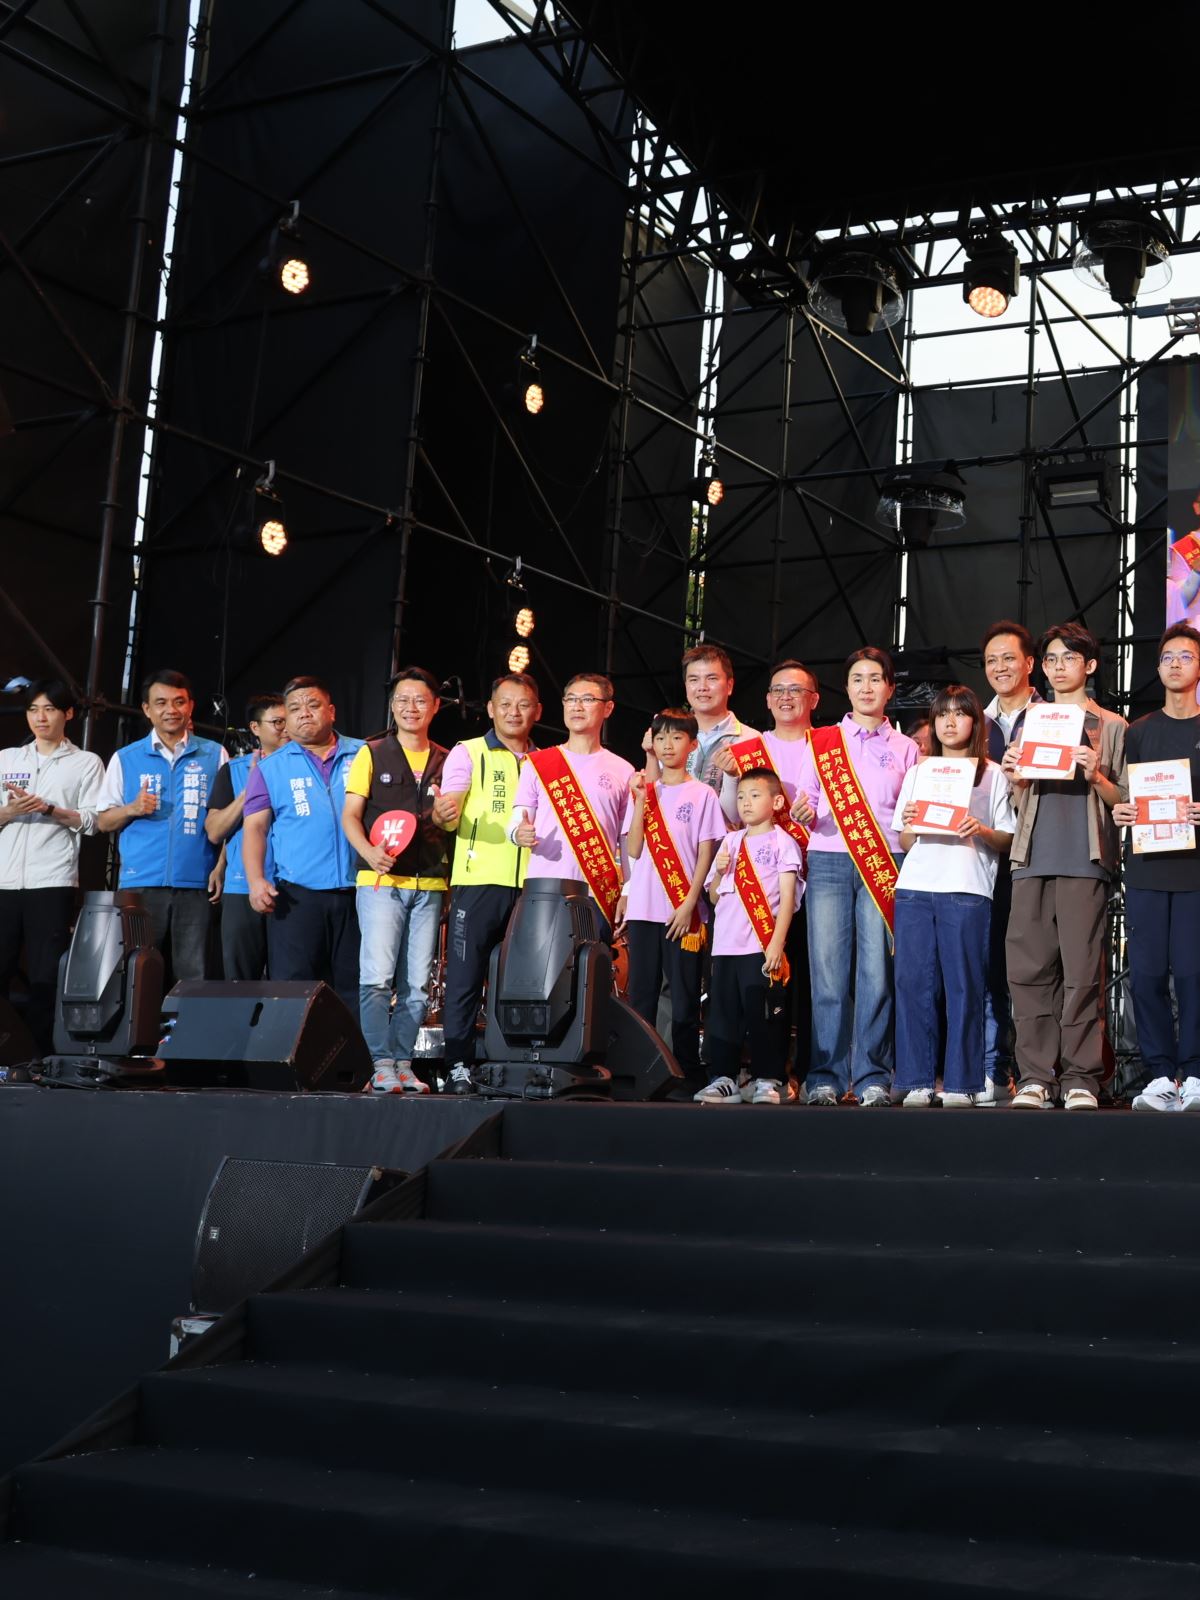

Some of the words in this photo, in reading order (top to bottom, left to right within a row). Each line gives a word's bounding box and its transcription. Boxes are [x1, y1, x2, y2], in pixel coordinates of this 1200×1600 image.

[290, 777, 311, 816] 陳景明
[491, 770, 506, 814] 黃品原
[854, 809, 878, 850] 主任委員
[663, 857, 687, 902] 小爐主
[749, 893, 773, 935] 小爐主
